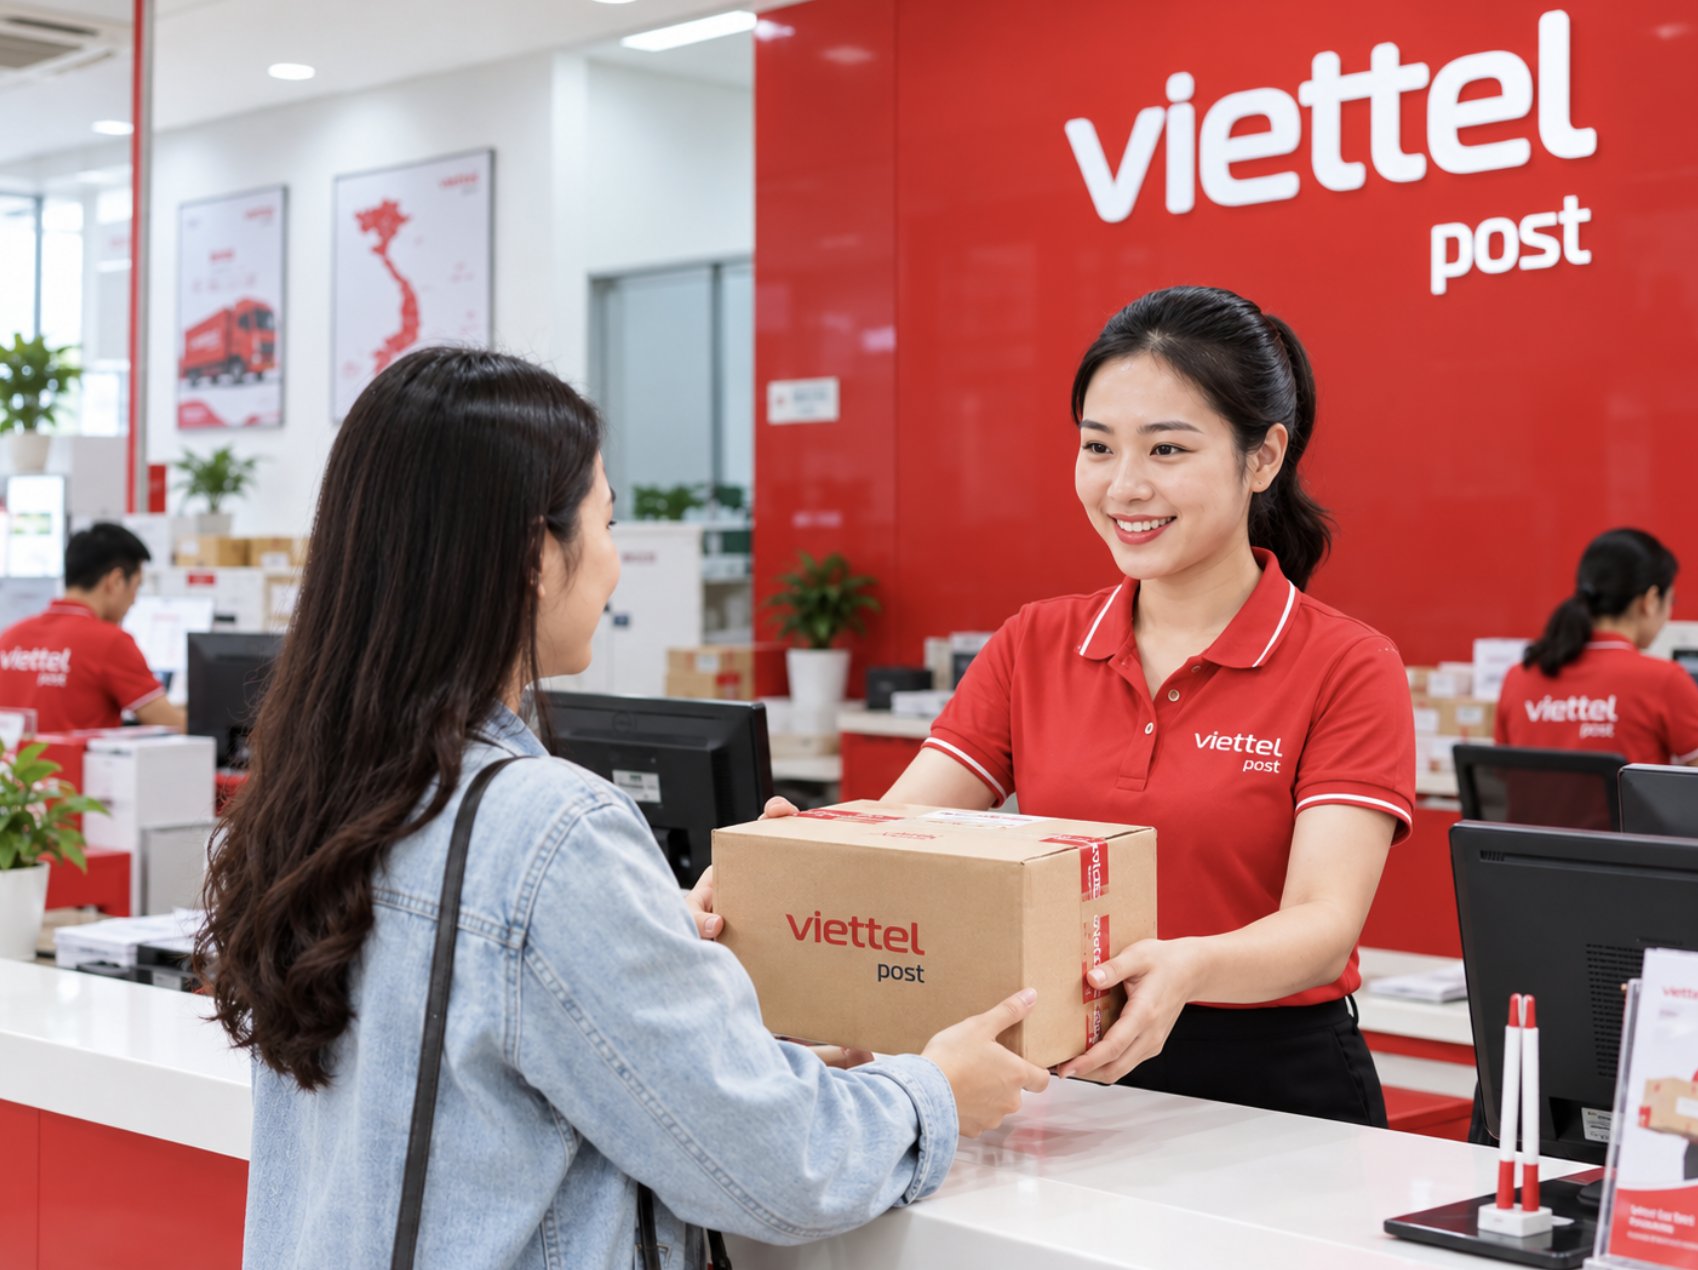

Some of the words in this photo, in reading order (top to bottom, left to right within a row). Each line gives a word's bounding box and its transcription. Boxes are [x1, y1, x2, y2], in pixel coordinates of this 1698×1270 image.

[1065, 9, 1597, 223] viettel
[1431, 195, 1592, 295] post
[0, 645, 71, 674] viettel
[1524, 694, 1618, 723] viettel
[1194, 731, 1283, 757] viettel
[1242, 760, 1281, 774] post
[785, 910, 925, 956] viettel
[877, 963, 925, 983] post
